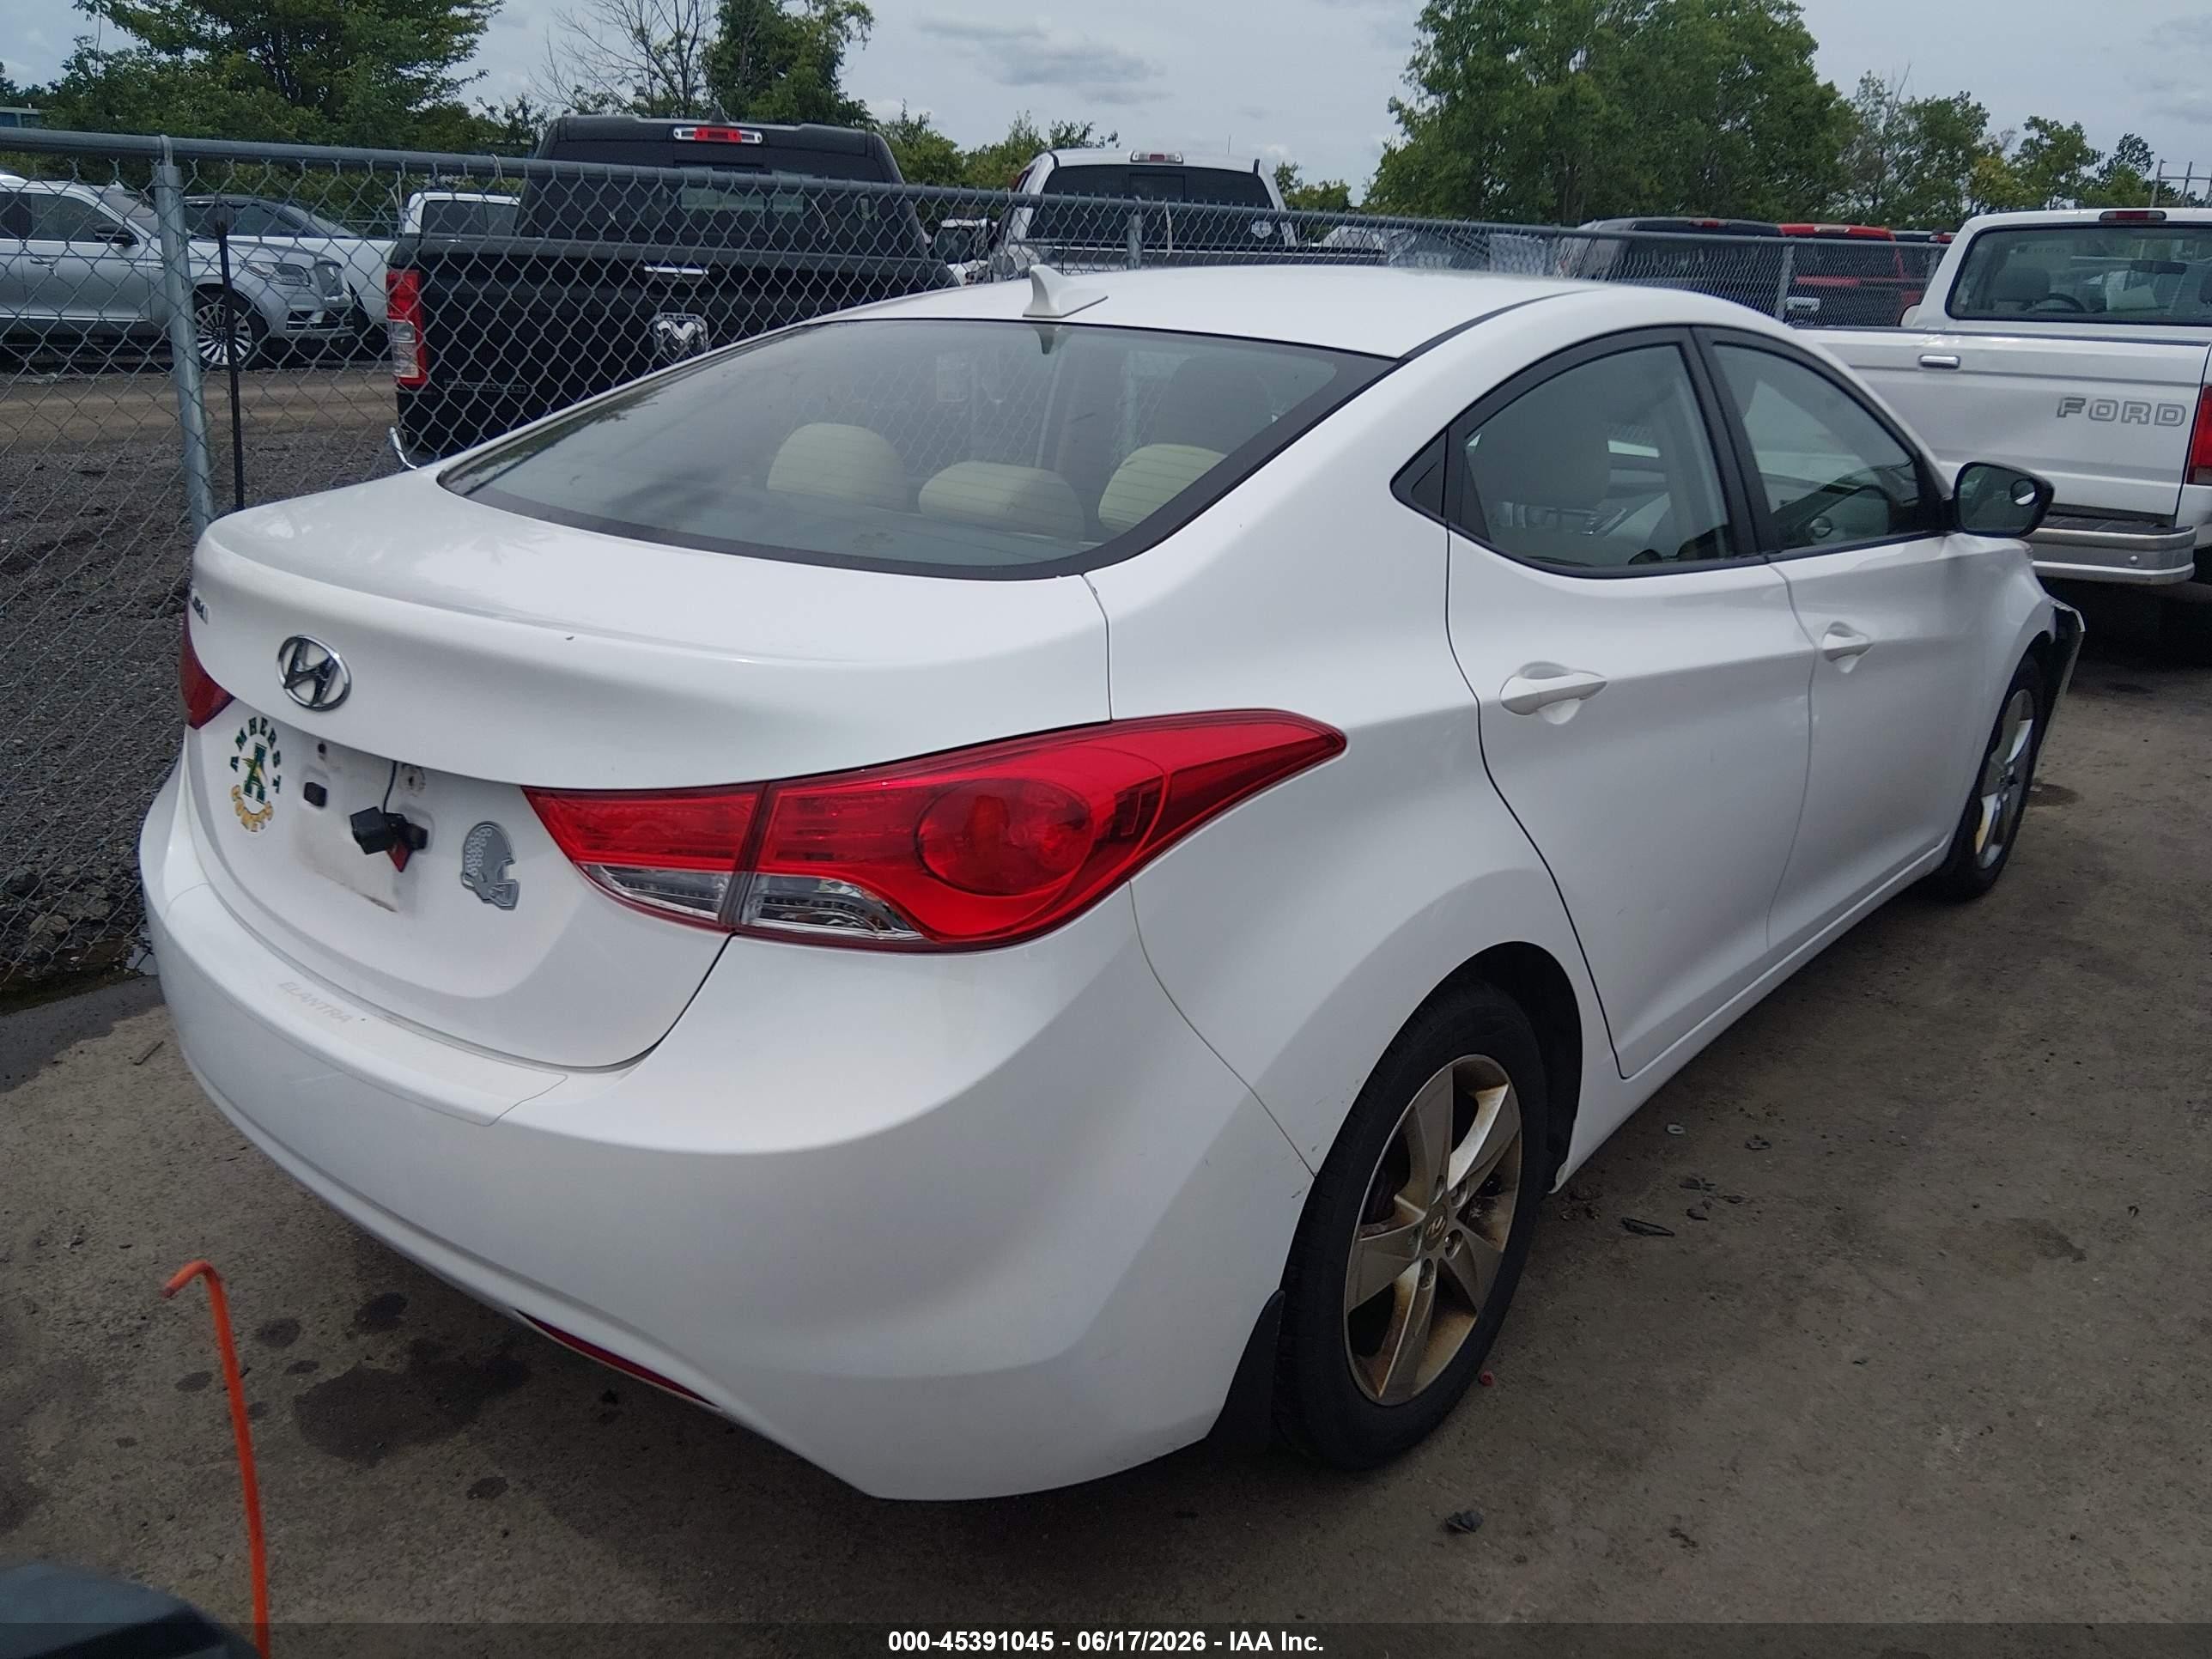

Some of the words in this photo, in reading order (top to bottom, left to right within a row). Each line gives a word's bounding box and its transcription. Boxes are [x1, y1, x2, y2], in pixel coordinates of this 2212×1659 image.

[2057, 397, 2187, 427] FORD
[230, 716, 281, 794] AMHERST
[277, 981, 354, 1024] ELANTRA
